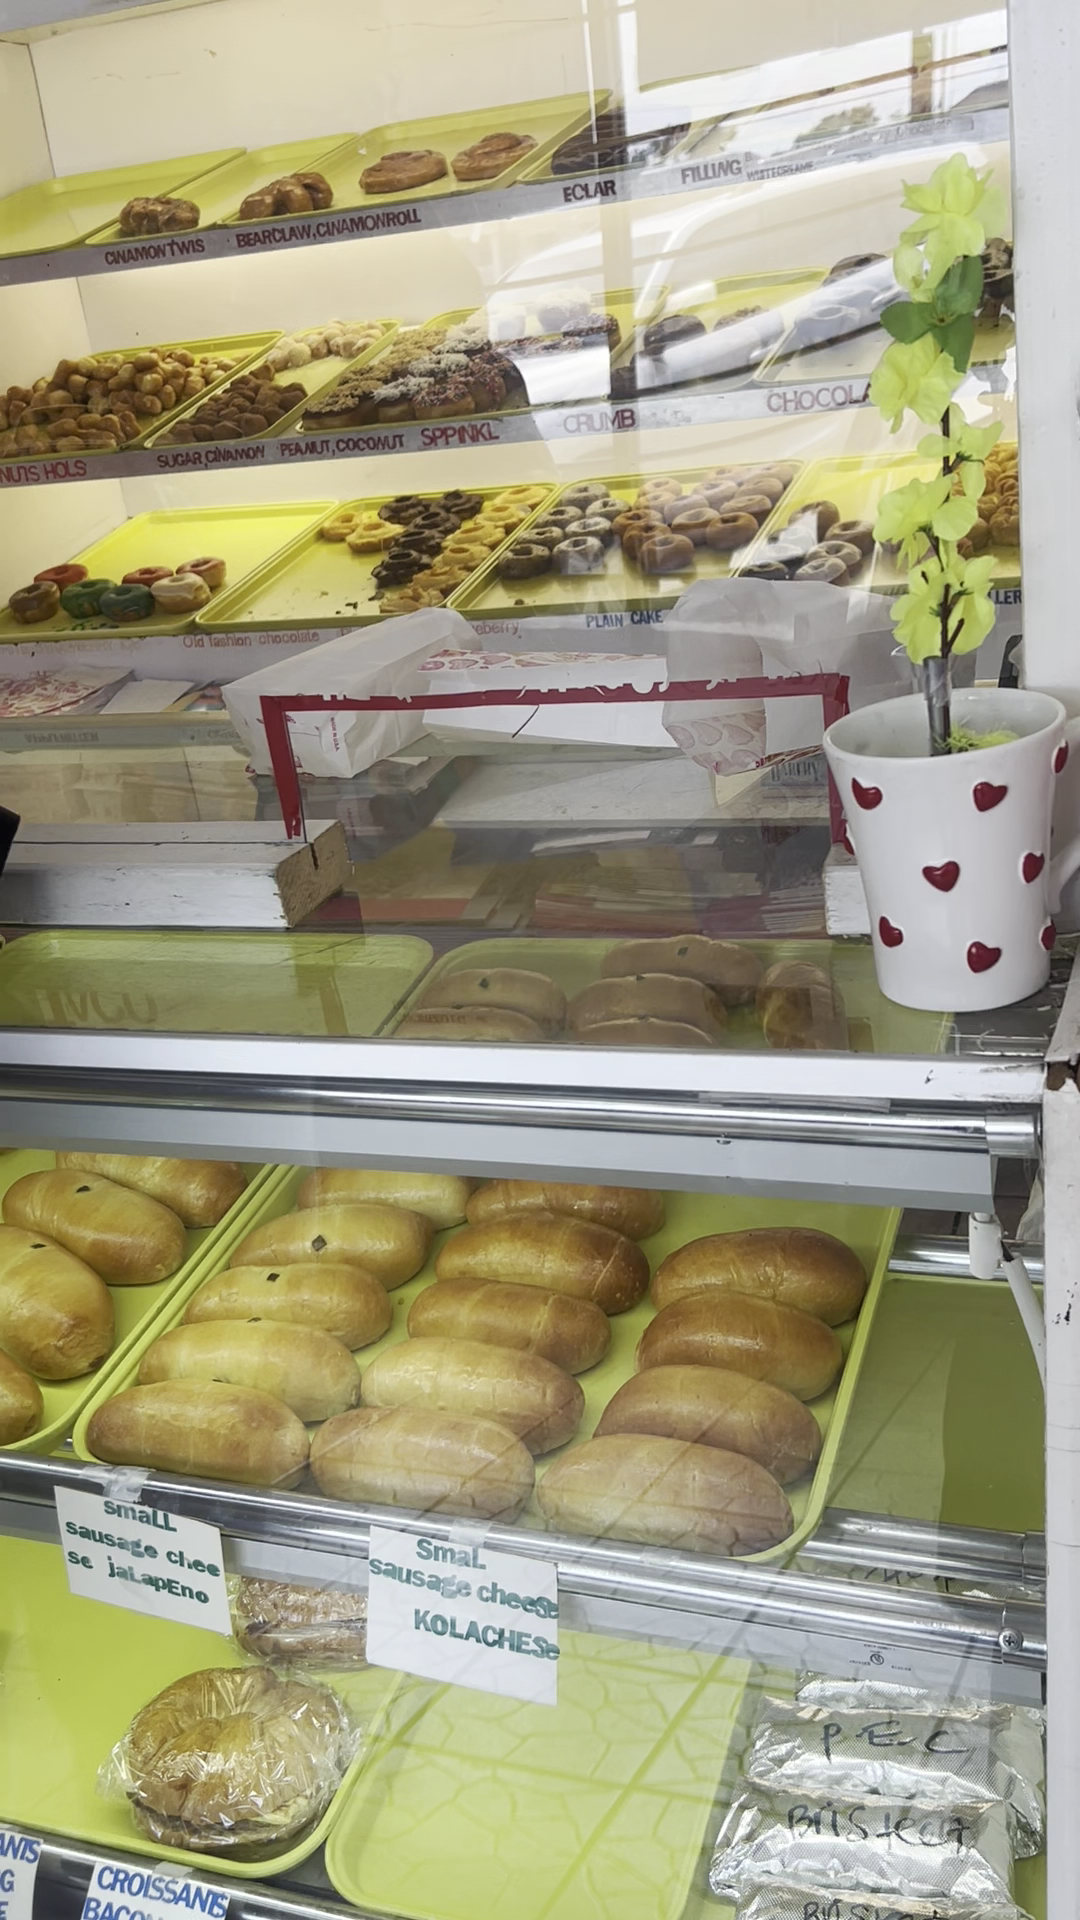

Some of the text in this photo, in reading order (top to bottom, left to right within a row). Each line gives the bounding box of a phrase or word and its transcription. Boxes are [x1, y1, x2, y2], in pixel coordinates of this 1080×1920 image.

[681, 159, 742, 184] FILLING
[563, 180, 616, 203] ECLAR
[562, 409, 636, 433] CRUMB
[43, 460, 87, 479] HOLS
[472, 621, 519, 636] eberry
[586, 609, 664, 628] PLAIN CAKE
[182, 635, 205, 648] Old
[258, 629, 320, 645] chocolate
[65, 1521, 221, 1577] sausage chee
[67, 1551, 94, 1569] se
[369, 1558, 472, 1599] sausage
[97, 1866, 231, 1918] CROISSANTS
